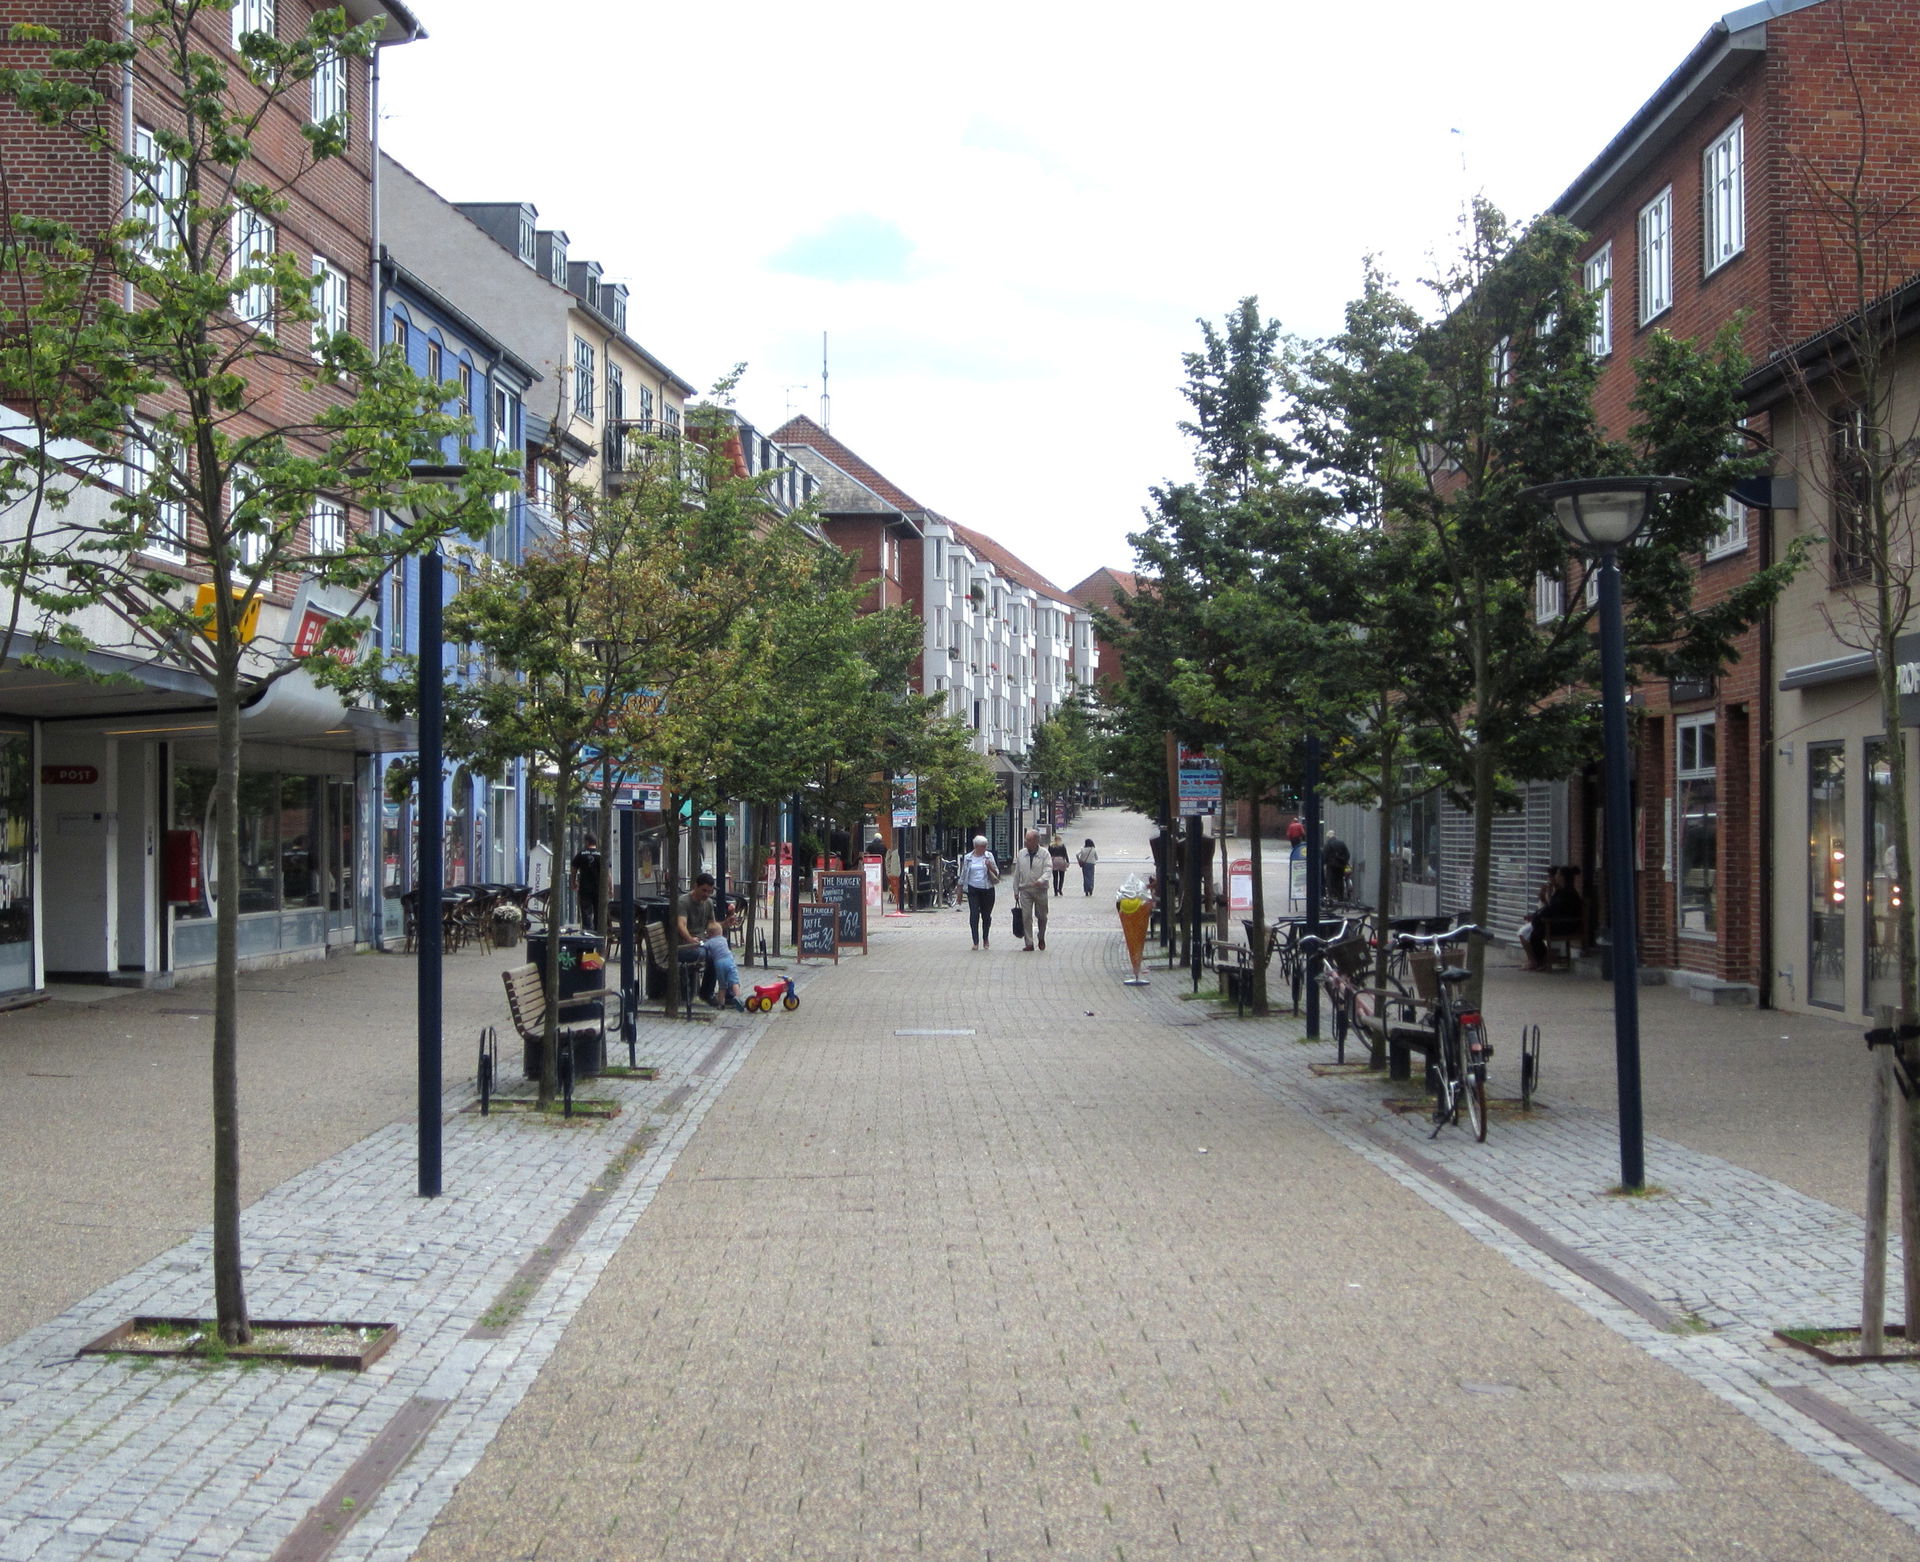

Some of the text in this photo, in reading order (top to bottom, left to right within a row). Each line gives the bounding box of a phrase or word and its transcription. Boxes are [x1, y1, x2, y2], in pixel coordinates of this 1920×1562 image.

[60, 770, 91, 780] POST
[823, 877, 861, 886] THE BURGER
